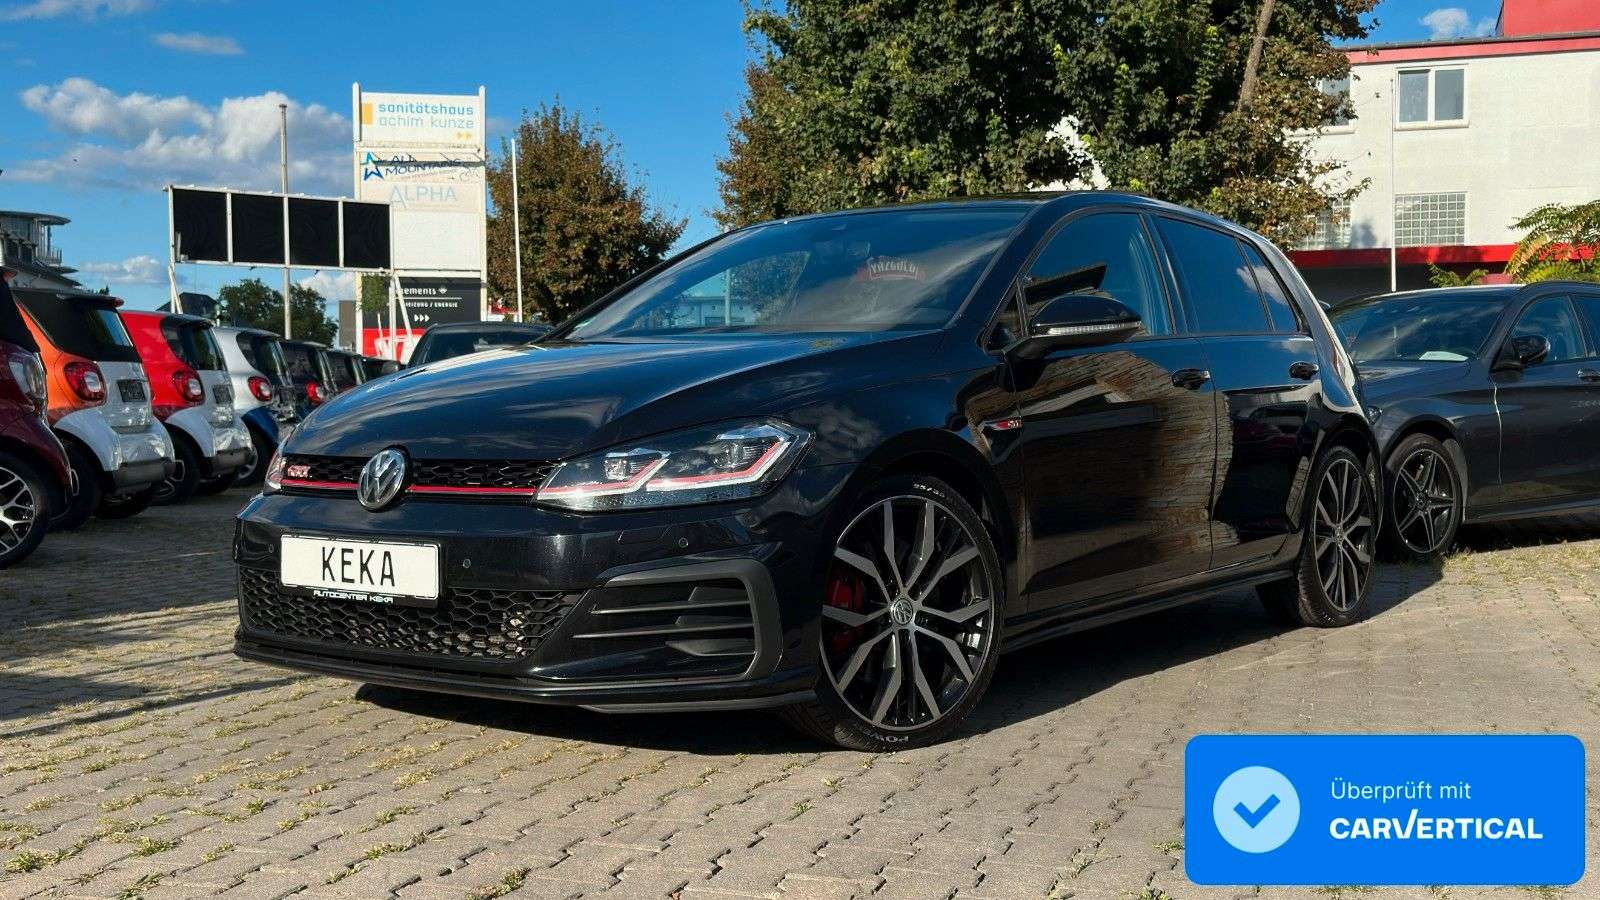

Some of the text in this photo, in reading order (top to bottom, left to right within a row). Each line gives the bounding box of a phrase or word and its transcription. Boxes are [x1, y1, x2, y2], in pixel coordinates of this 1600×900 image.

[378, 102, 475, 116] sanitätshaus
[379, 115, 475, 129] achim kunze
[389, 184, 459, 209] ALPHA
[322, 546, 395, 587] KEKA
[313, 590, 394, 604] AUTOCENTER KEKA
